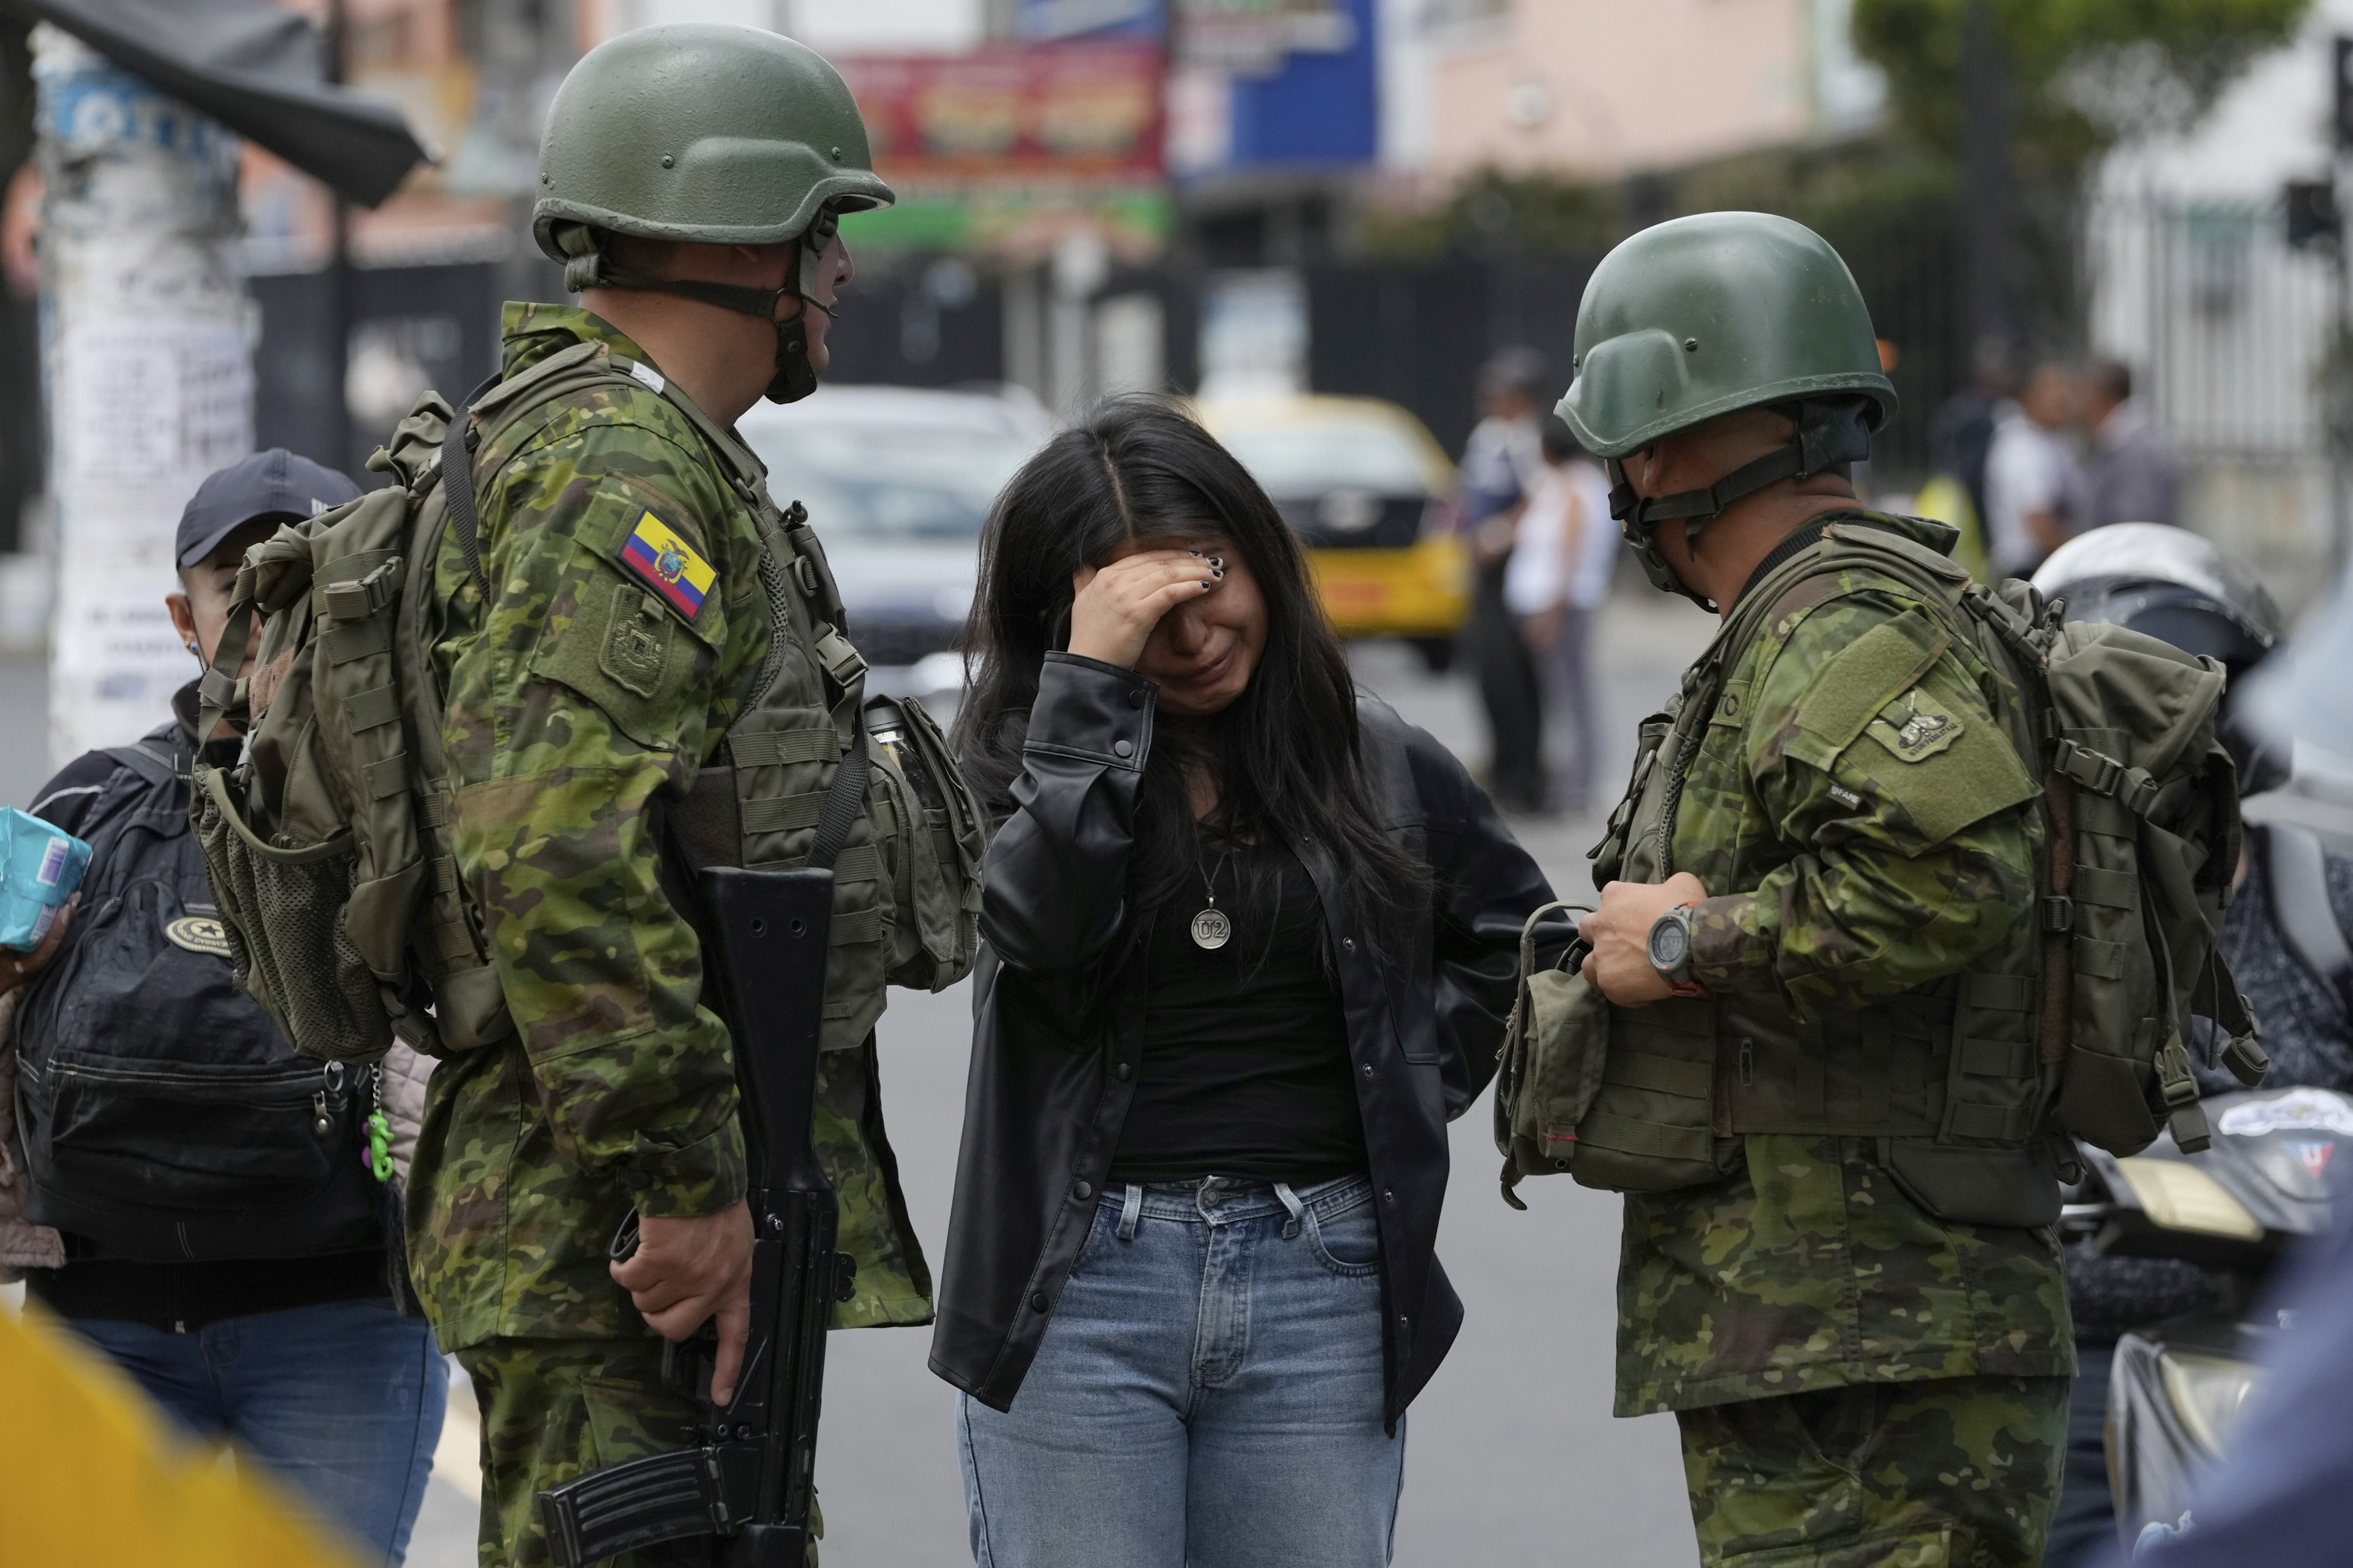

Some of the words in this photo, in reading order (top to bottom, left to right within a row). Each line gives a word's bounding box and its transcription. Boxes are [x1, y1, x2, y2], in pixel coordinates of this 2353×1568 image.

[1717, 691, 1739, 716] TO
[1837, 788, 1861, 803] FAME
[1197, 920, 1225, 939] U2
